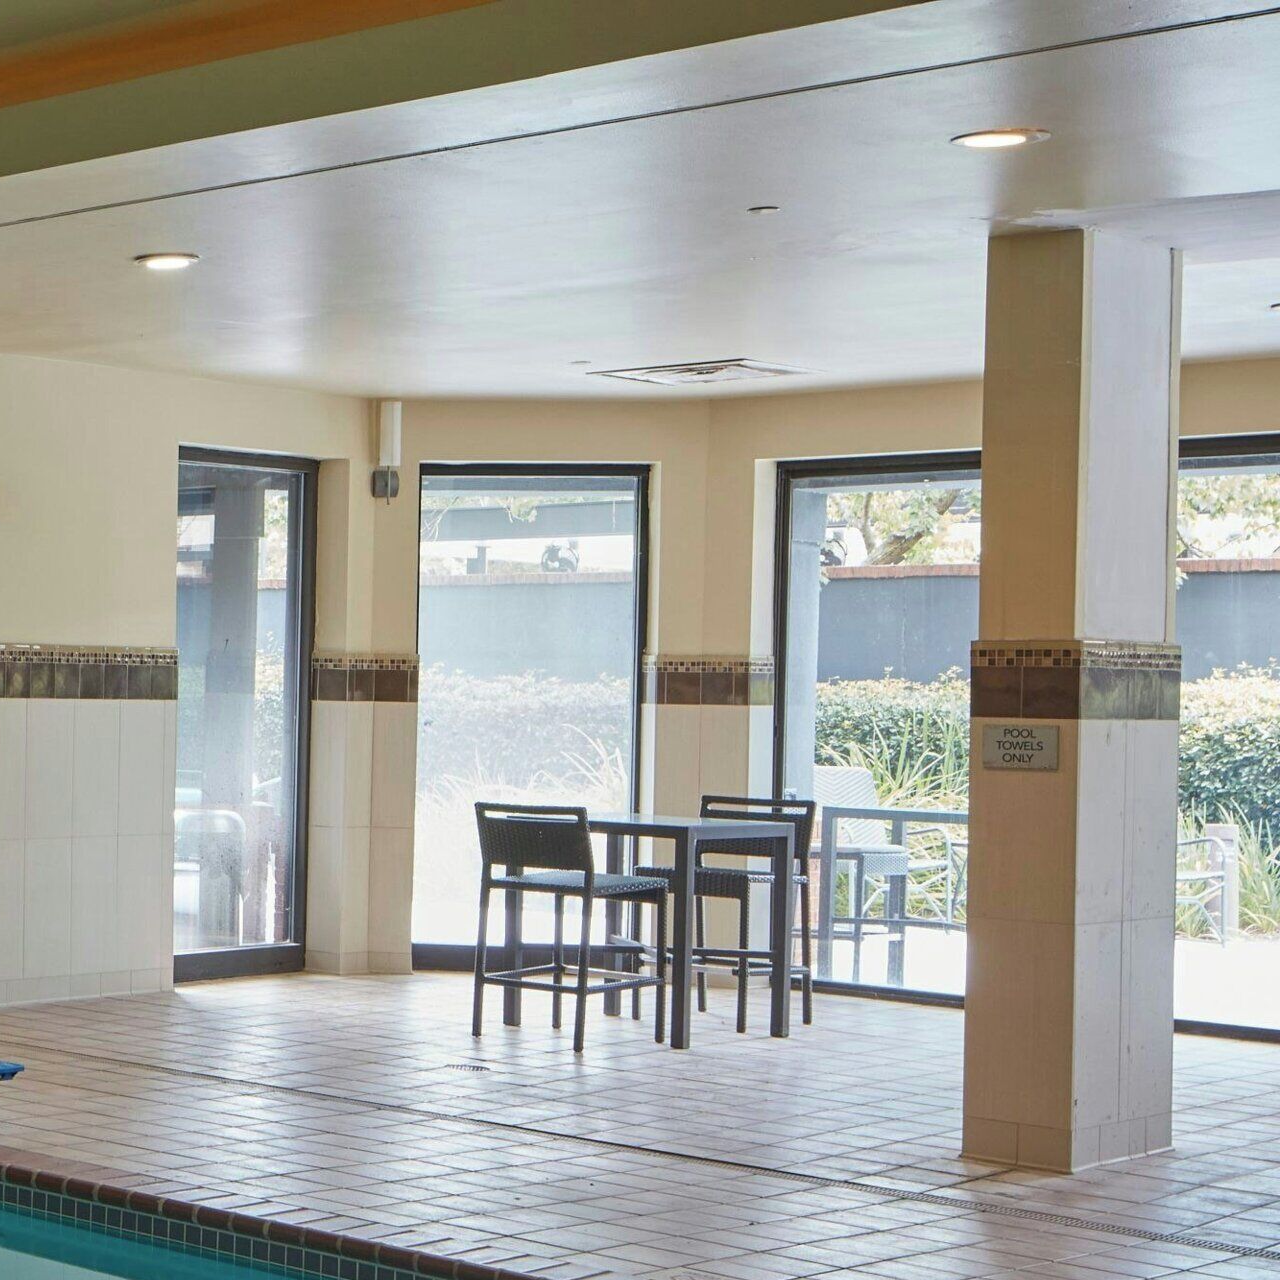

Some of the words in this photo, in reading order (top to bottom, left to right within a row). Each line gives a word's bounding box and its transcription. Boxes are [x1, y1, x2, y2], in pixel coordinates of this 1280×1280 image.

[1004, 728, 1036, 739] POOL
[996, 740, 1044, 751] TOWELS
[1002, 752, 1034, 763] ONLY
